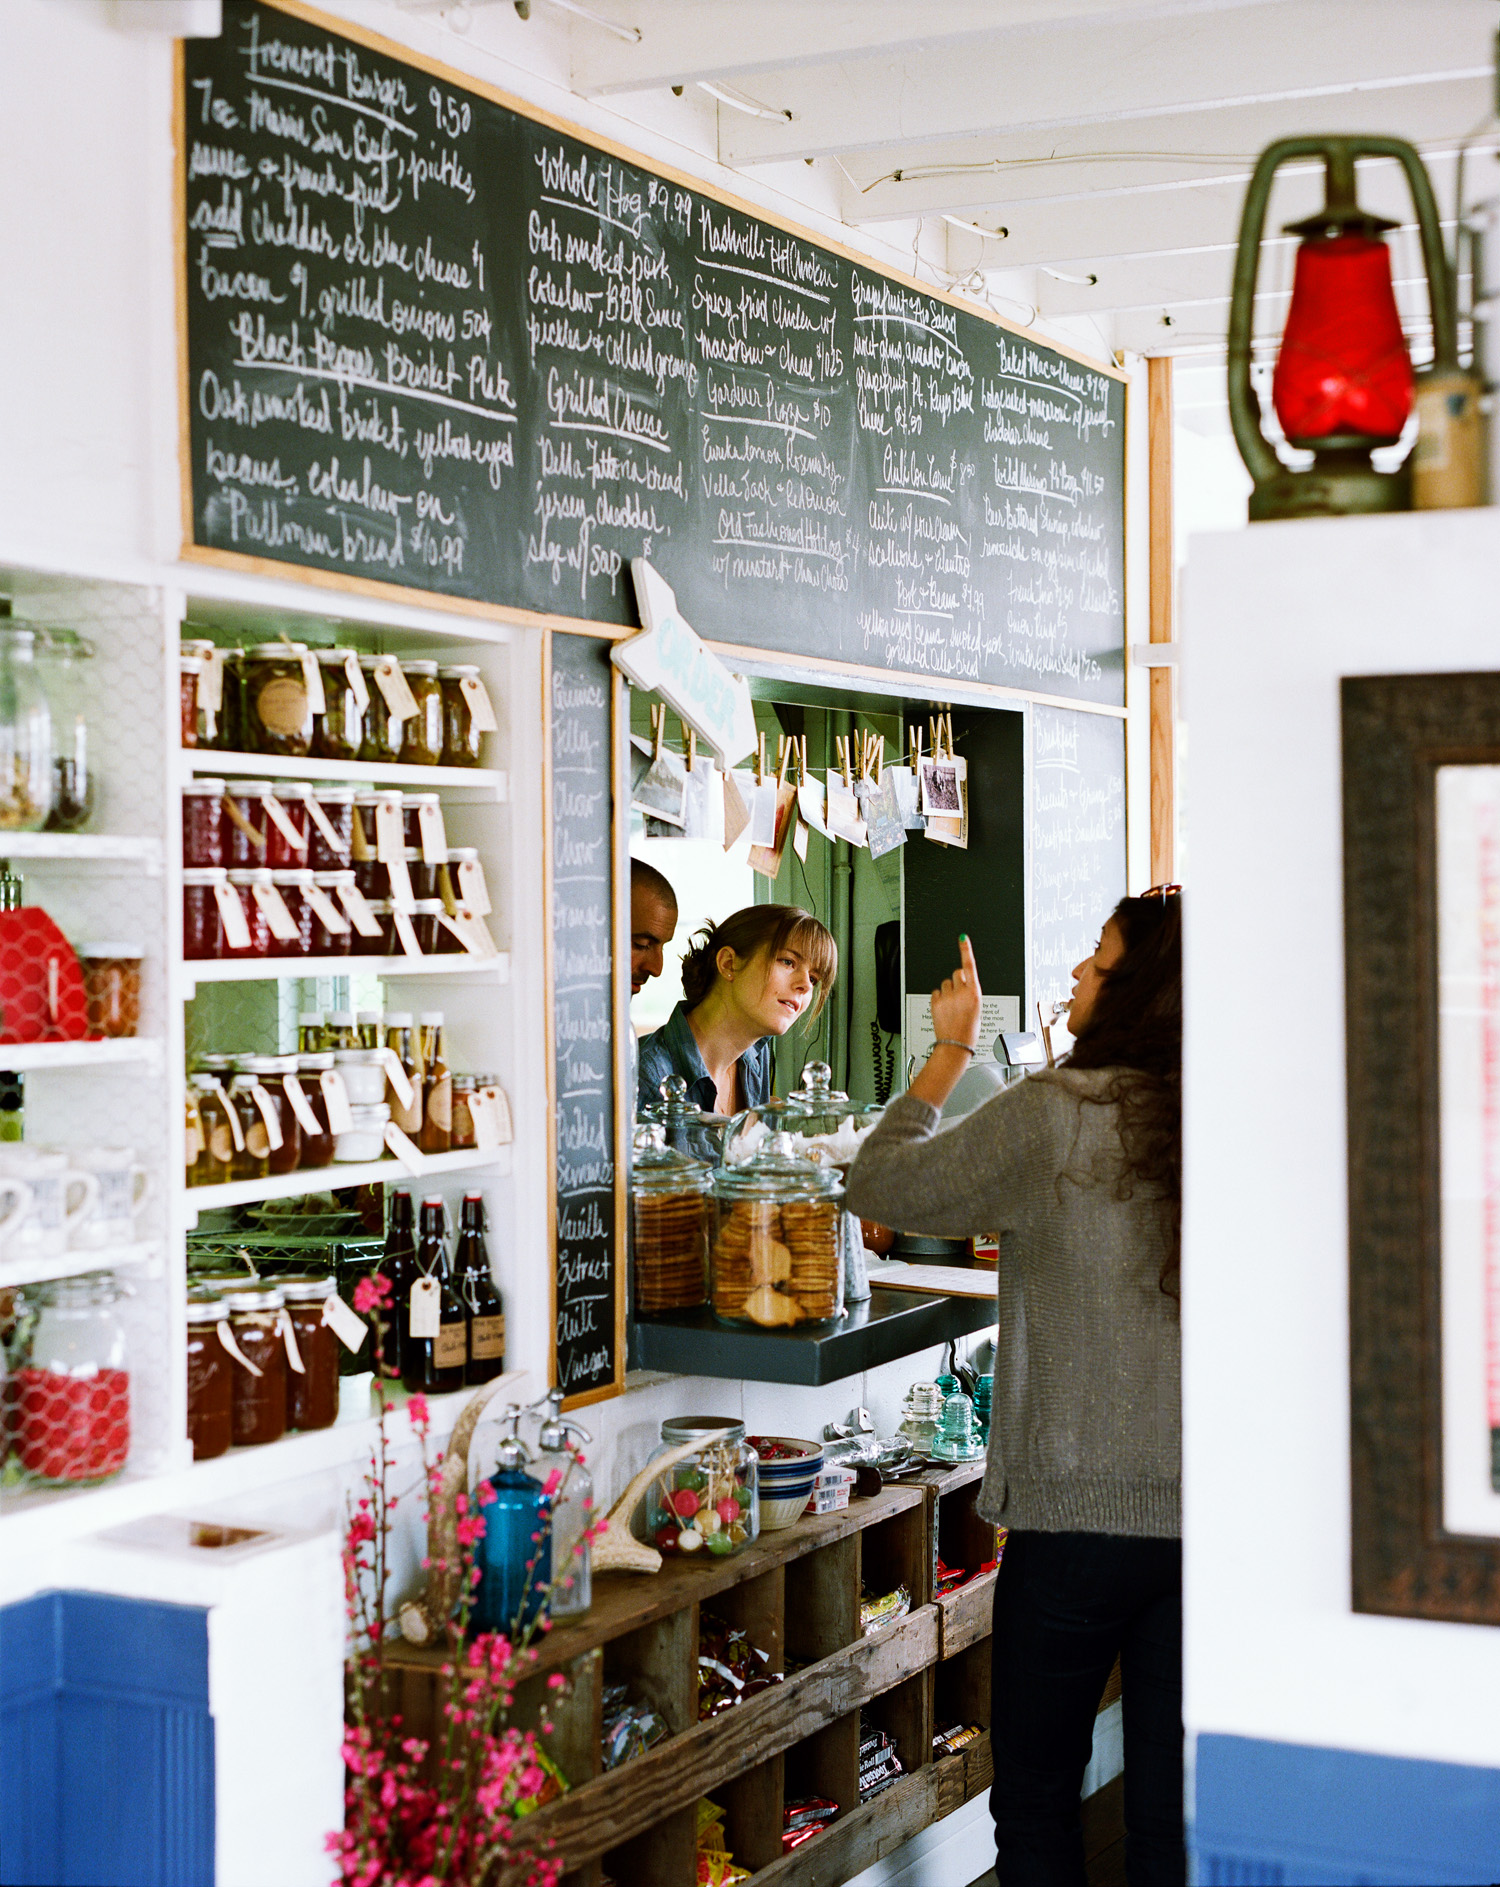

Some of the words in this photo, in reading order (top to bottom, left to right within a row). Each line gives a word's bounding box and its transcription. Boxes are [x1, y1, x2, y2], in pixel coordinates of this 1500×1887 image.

[239, 13, 336, 87] Fremont
[534, 146, 598, 206] Whole
[189, 182, 245, 246] add
[372, 223, 413, 272] blue
[529, 210, 561, 261] Oak
[698, 204, 766, 261] Nashville
[996, 337, 1027, 378] Baked
[1028, 350, 1051, 379] Mac
[200, 369, 252, 425] Oak
[548, 366, 611, 426] Grilled
[614, 387, 669, 440] Cheese
[416, 490, 455, 525] on
[701, 473, 742, 499] Vella
[741, 469, 778, 507] Jack
[718, 508, 744, 539] Old
